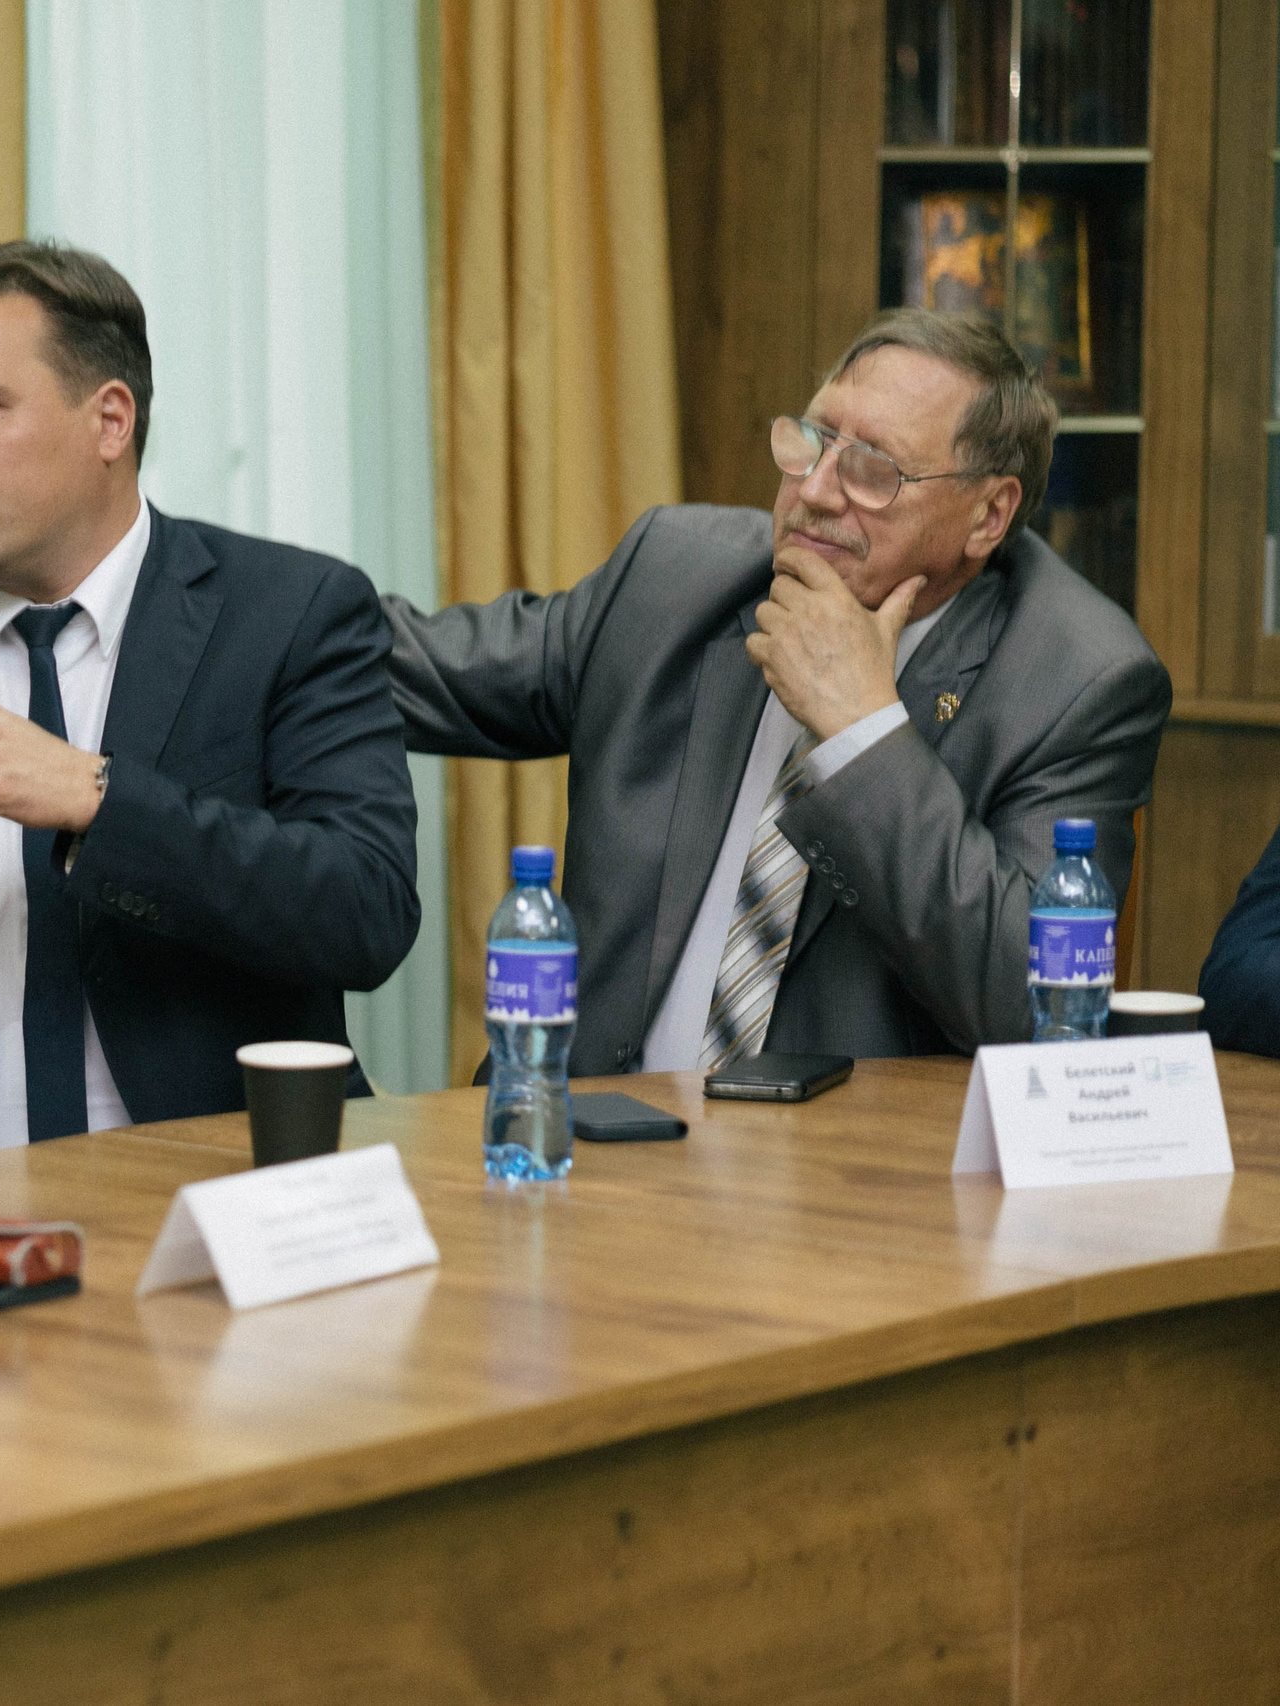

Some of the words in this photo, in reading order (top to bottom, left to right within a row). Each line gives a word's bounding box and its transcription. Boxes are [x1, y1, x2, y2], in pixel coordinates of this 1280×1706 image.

[1065, 1062, 1135, 1078] Белетский
[1080, 1084, 1130, 1101] Андрей
[1069, 1109, 1148, 1122] Васильевич
